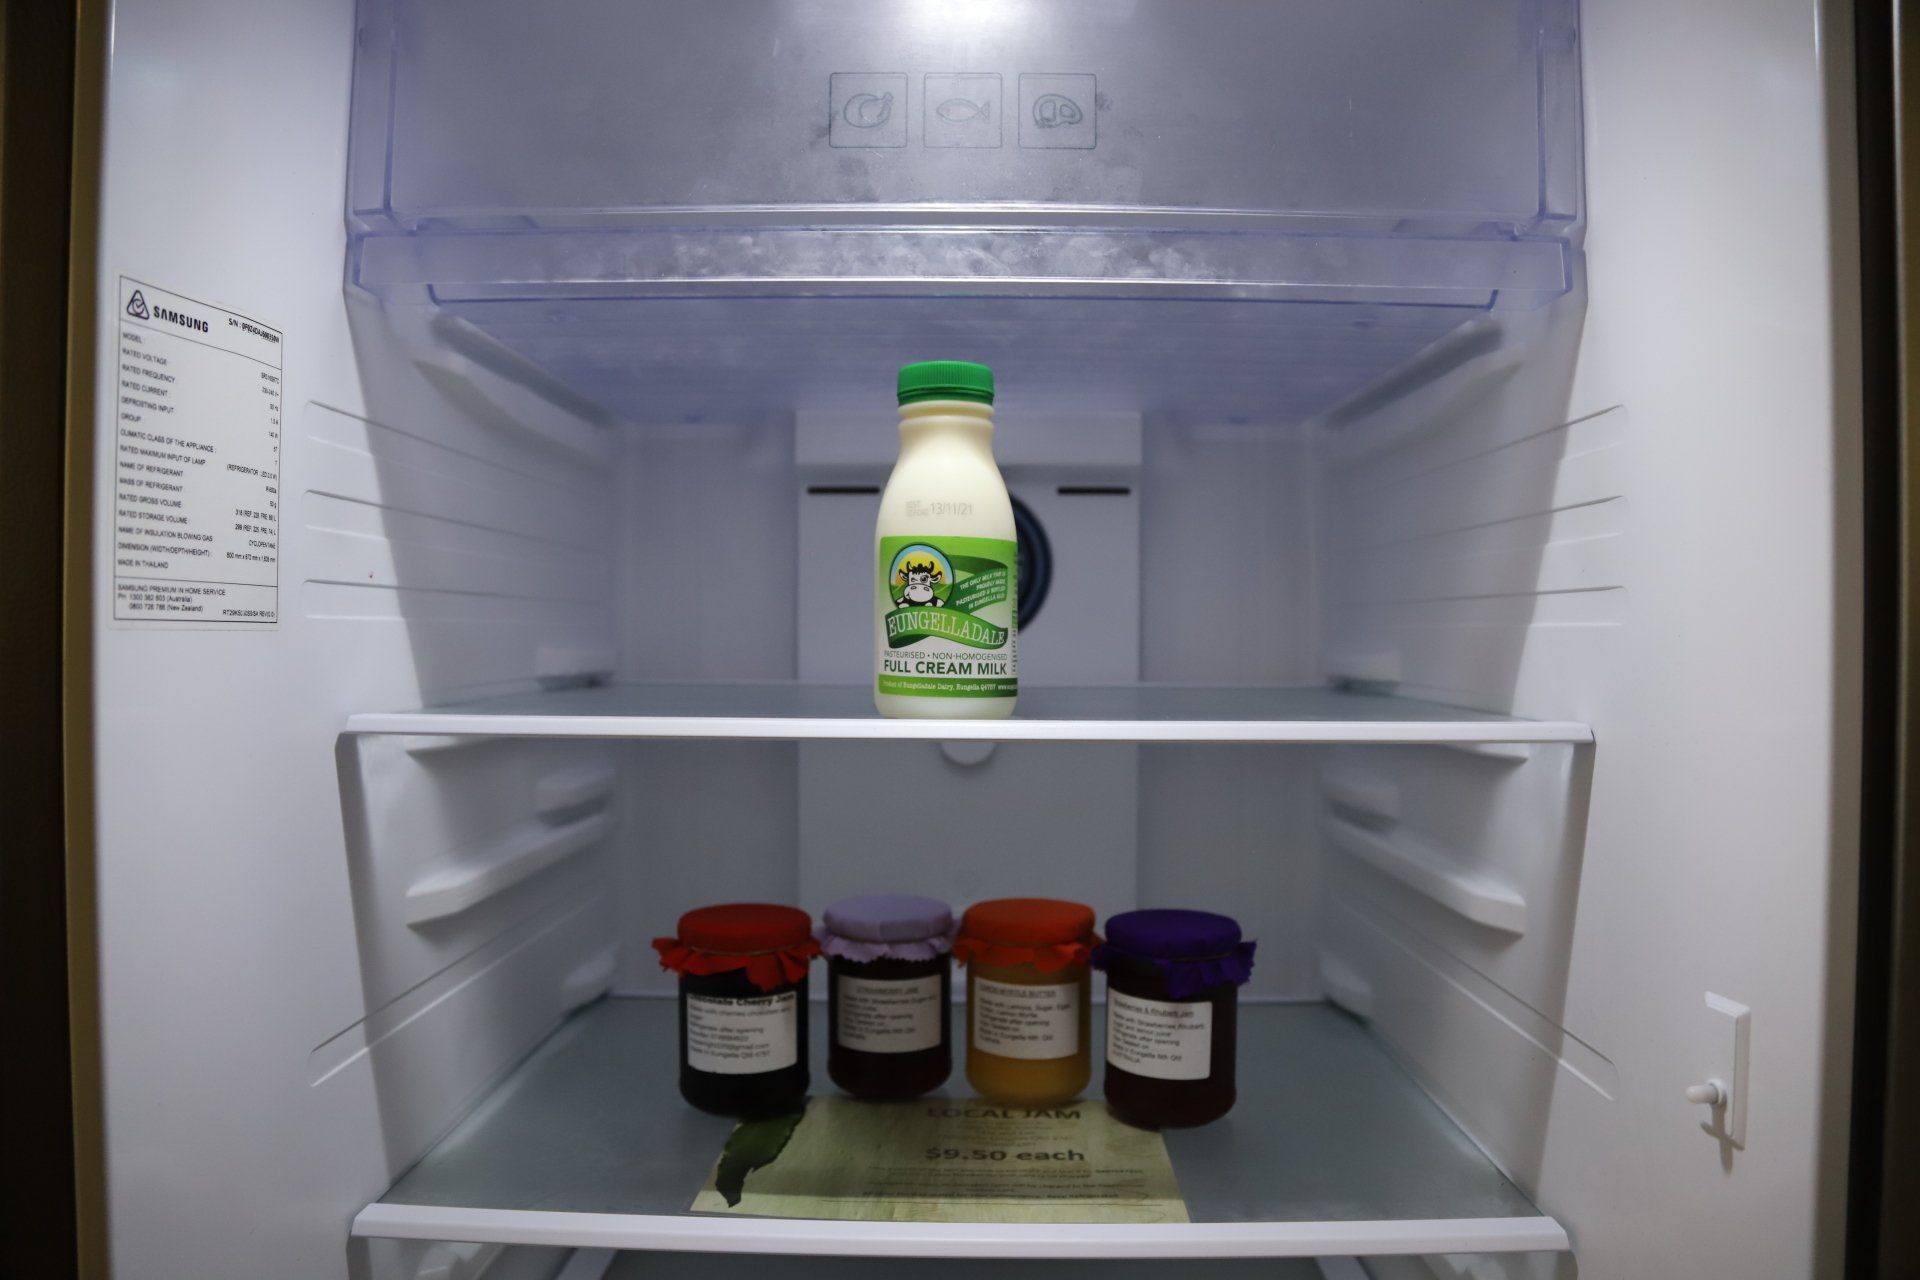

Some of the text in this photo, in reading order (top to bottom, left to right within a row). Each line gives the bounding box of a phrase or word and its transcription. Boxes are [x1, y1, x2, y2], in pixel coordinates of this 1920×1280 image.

[154, 306, 208, 333] SAMSUNG
[122, 347, 167, 365] RATED VOLTAGE
[122, 364, 176, 383] RATED FREQUENCY
[122, 380, 168, 396] RATED CURRENT
[121, 396, 174, 414] DEFROSTING INPUT
[121, 412, 141, 422] GROUP
[121, 428, 146, 440] CLIMATIC
[147, 433, 165, 443] CLASS
[175, 439, 184, 447] THE
[186, 441, 214, 453] APPLIANCE
[120, 444, 206, 466] RATED MAXIMUM INPUT OF LAMP
[119, 461, 135, 470] NAME
[146, 464, 183, 477] REFRIGERANT
[119, 477, 135, 486] MASS
[145, 480, 183, 492] REFRIGERANT
[119, 493, 182, 508] RATED GROSS VOLUME
[930, 502, 973, 516] 13/11/21
[119, 510, 188, 524] RATED STORAGE VOLUME
[144, 529, 176, 538] INSULATION
[177, 532, 201, 541] BLOWING
[118, 542, 149, 552] DIMENSION
[142, 561, 168, 569] THAILAND
[118, 584, 148, 592] SAMSUNG
[960, 580, 969, 590] THE
[969, 576, 982, 587] ONLY
[888, 611, 1005, 645] EUNGELLADALE
[884, 650, 1007, 661] PASTEURISED NON-HOMOGENISED
[884, 660, 1006, 675] FULL CREAM MILK
[903, 681, 936, 690] Eungelladale
[956, 683, 979, 691] Eungella
[736, 997, 773, 1007] Cherry
[776, 994, 794, 1003] Jam
[927, 1106, 1081, 1120] LOCAL JAM
[925, 1148, 1084, 1161] $9.50 each
